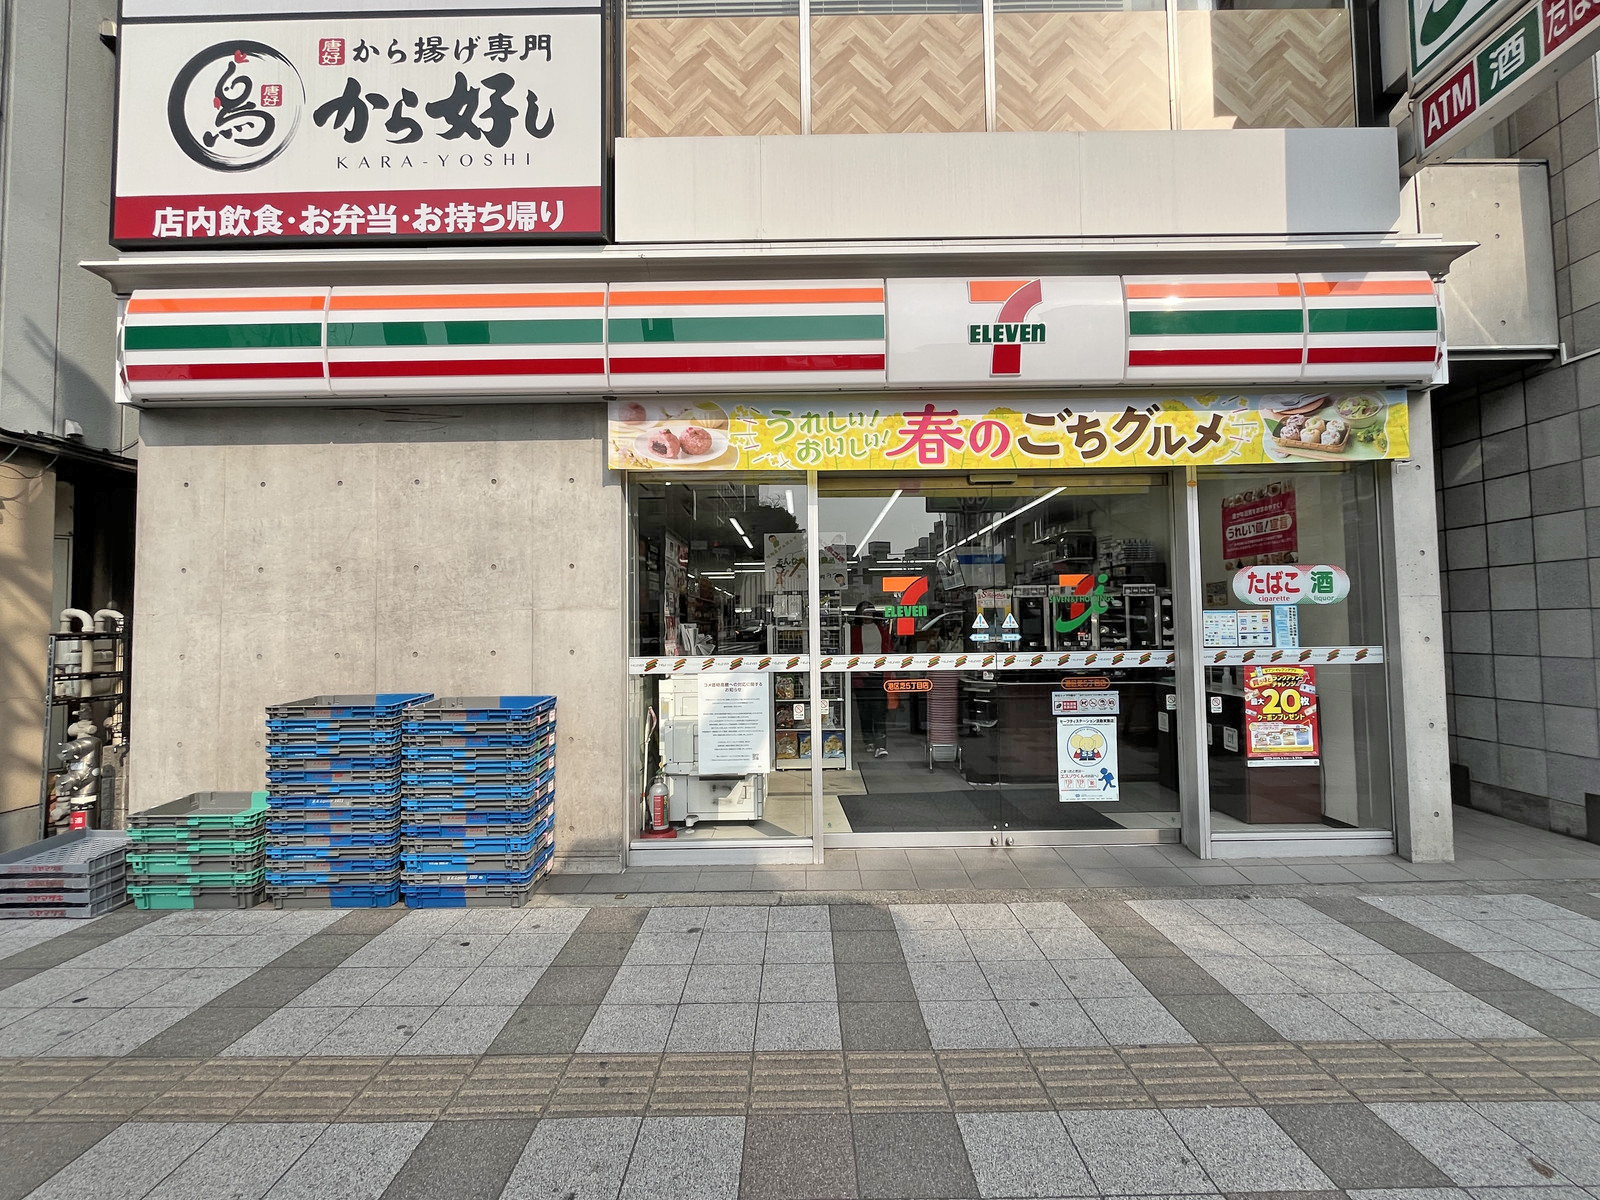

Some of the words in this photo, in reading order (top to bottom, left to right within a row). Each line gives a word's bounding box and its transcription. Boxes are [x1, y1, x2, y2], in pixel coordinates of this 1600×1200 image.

[1547, 0, 1600, 43] たば
[353, 33, 553, 64] から揚げ専門
[1489, 27, 1525, 90] 酒
[313, 72, 555, 148] から好し
[1427, 73, 1472, 138] ATM
[336, 152, 533, 169] KARA-YOSHI
[885, 402, 1224, 465] 春のごちグルメ
[1248, 571, 1300, 594] たばこ
[1310, 571, 1334, 594] 酒
[1261, 688, 1302, 714] 20
